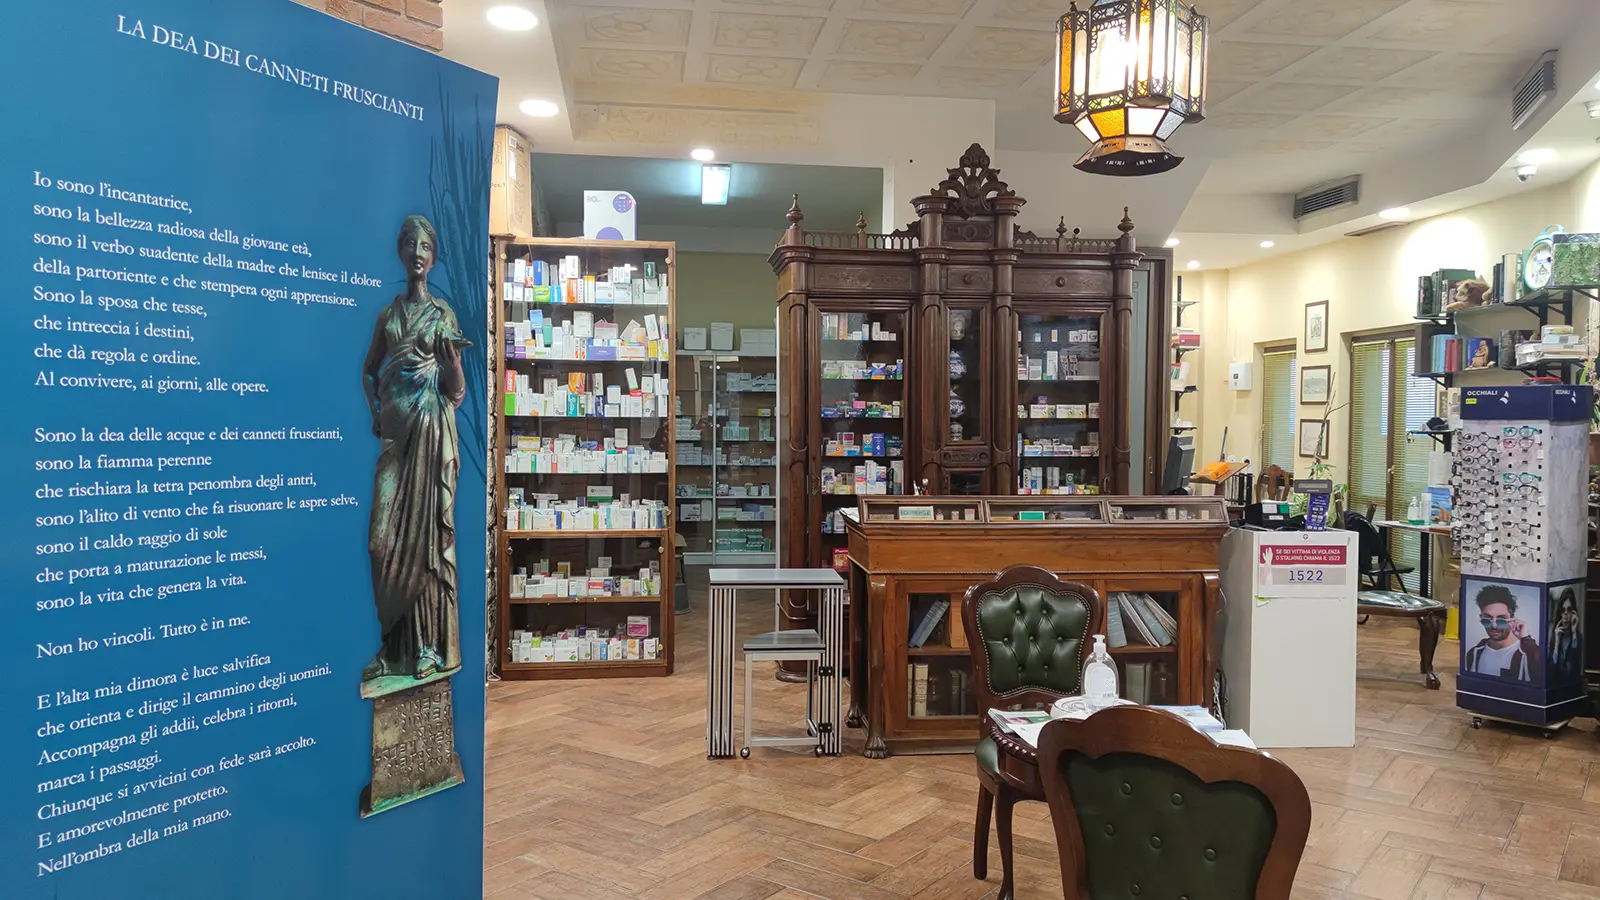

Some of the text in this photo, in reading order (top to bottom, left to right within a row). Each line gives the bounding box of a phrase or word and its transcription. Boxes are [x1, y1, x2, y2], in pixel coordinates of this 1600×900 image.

[117, 14, 424, 121] LA DEA DEI CANNETI FRUSCIANTI
[34, 171, 52, 187] Io
[57, 180, 95, 195] sono
[33, 204, 312, 257] sono la bellezza radiosa della giovane età,
[33, 233, 382, 288] sono il verbo suadente della madre che lenisce il dolore
[33, 257, 357, 307] della partoriente e che stempera ogni apprensione.
[33, 285, 207, 318] Sono la sposa che tesse,
[33, 314, 194, 342] che intreccia i destini,
[34, 343, 200, 365] che dà regola e ordine.
[34, 371, 269, 396] Al convivere, ai giorni, alle opere.
[35, 427, 343, 445] Sono la dea delle acque e dei canneti fruscianti,
[35, 454, 212, 471] sono la fiamma perenne
[35, 473, 317, 499] che rischiara la tetra penombra degli antri,
[36, 515, 74, 527] sono
[123, 506, 138, 521] di
[142, 507, 181, 519] vento
[185, 502, 208, 516] che
[213, 501, 224, 514] fa
[228, 500, 283, 513] risuonare
[287, 497, 296, 509] le
[299, 498, 328, 511] aspre
[330, 493, 358, 506] selve,
[36, 525, 227, 555] sono il caldo raggio di sole
[36, 546, 267, 584] che porta a maturazione le messi,
[1289, 570, 1323, 581] 1522
[36, 573, 247, 611] sono la vita che genera la vita.
[36, 616, 251, 658] Non ho vincoli. Tutto è in me.
[37, 694, 51, 710] E
[94, 681, 123, 698] mia
[127, 674, 177, 692] dimora
[181, 668, 189, 681] è
[193, 666, 218, 679] luce
[222, 654, 271, 673] salvifica
[37, 663, 332, 737] che orienta e dirige il cammino degli uomini.
[37, 693, 297, 766] Accompagna gli addii, celebra i ritorni,
[37, 750, 162, 793] marca i passaggi.
[37, 736, 316, 820] Chiunque si avvicini con fede sarà accolto.
[38, 786, 228, 849] E amorevolmente protetto.
[126, 828, 159, 848] della
[163, 819, 188, 837] mia
[193, 809, 232, 827] mano.
